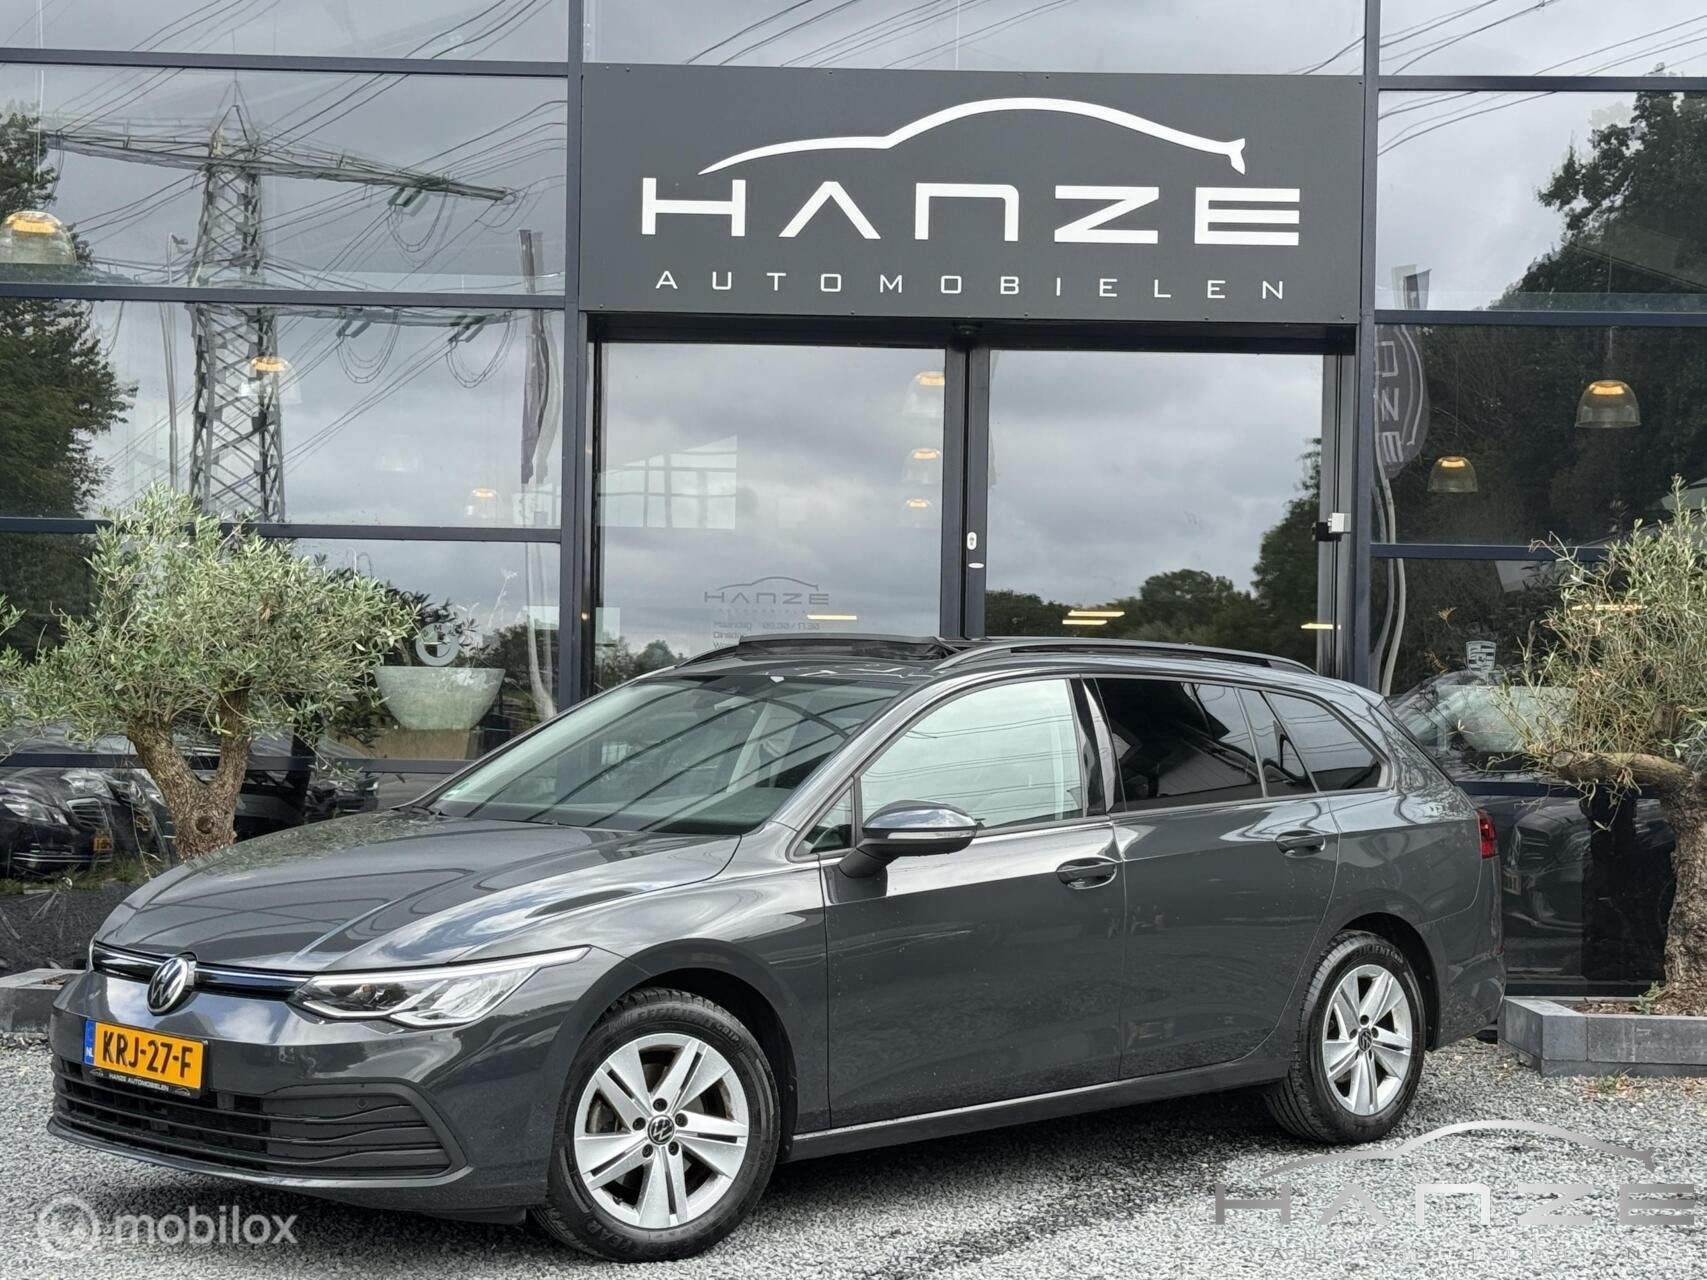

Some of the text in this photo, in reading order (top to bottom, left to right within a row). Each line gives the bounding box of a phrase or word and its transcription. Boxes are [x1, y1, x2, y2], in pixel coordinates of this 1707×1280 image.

[641, 177, 1301, 246] HANZE
[655, 270, 1285, 300] AUTOMOBIELEN
[704, 591, 830, 605] HANZE
[102, 1030, 194, 1079] KRJ-27-F
